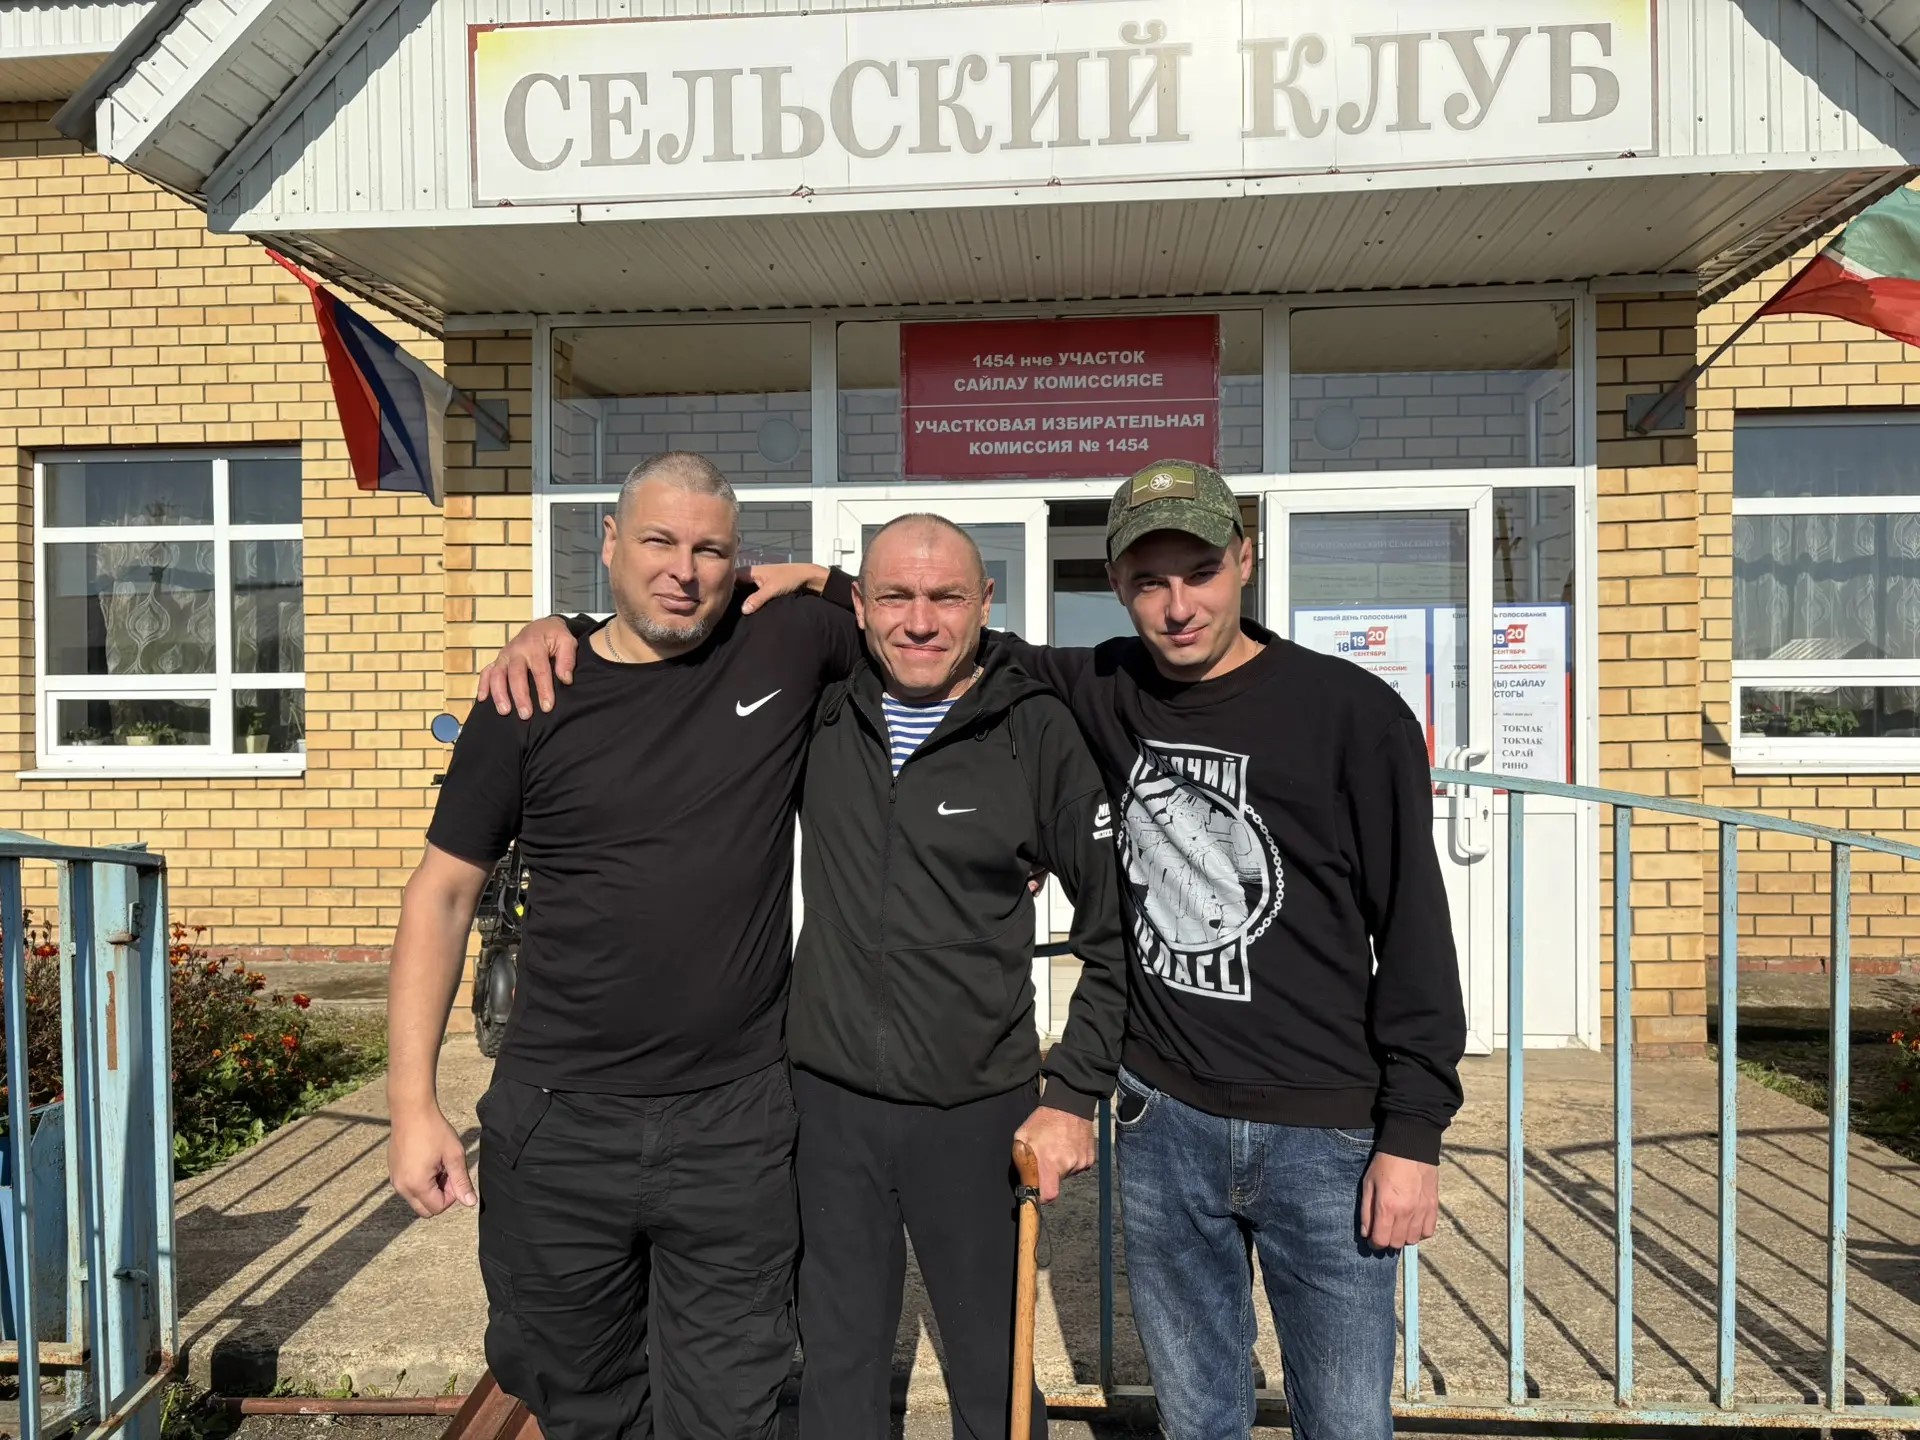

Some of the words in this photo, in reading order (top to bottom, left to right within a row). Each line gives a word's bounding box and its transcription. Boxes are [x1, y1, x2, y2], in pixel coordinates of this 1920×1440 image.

[503, 20, 1192, 172] СЕЛЬСКИЙ
[1239, 22, 1620, 140] КЛУБ
[972, 354, 1016, 368] 1454
[1020, 354, 1053, 367] нче
[1058, 350, 1146, 366] УЧАСТОК
[954, 375, 1028, 392] САЙЛАУ
[1033, 373, 1163, 391] КОМИССИЯСЕ
[915, 418, 1036, 434] УЧАСТКОВАЯ
[1042, 413, 1205, 431] ИЗБИРАТЕЛЬНАЯ
[969, 440, 1073, 455] КОМИССИЯ
[1078, 438, 1100, 453] №
[1106, 438, 1149, 452] 1454
[1507, 628, 1524, 639] 20
[1336, 642, 1350, 653] 18
[1352, 635, 1366, 647] 19
[1367, 630, 1385, 641] 20
[1509, 678, 1546, 688] САЙЛАУ
[1494, 690, 1524, 698] СТОГЫ
[1502, 724, 1543, 733] ТОКМАК
[1502, 737, 1543, 745] ТОКМАК
[1502, 748, 1534, 757] САРАЙ
